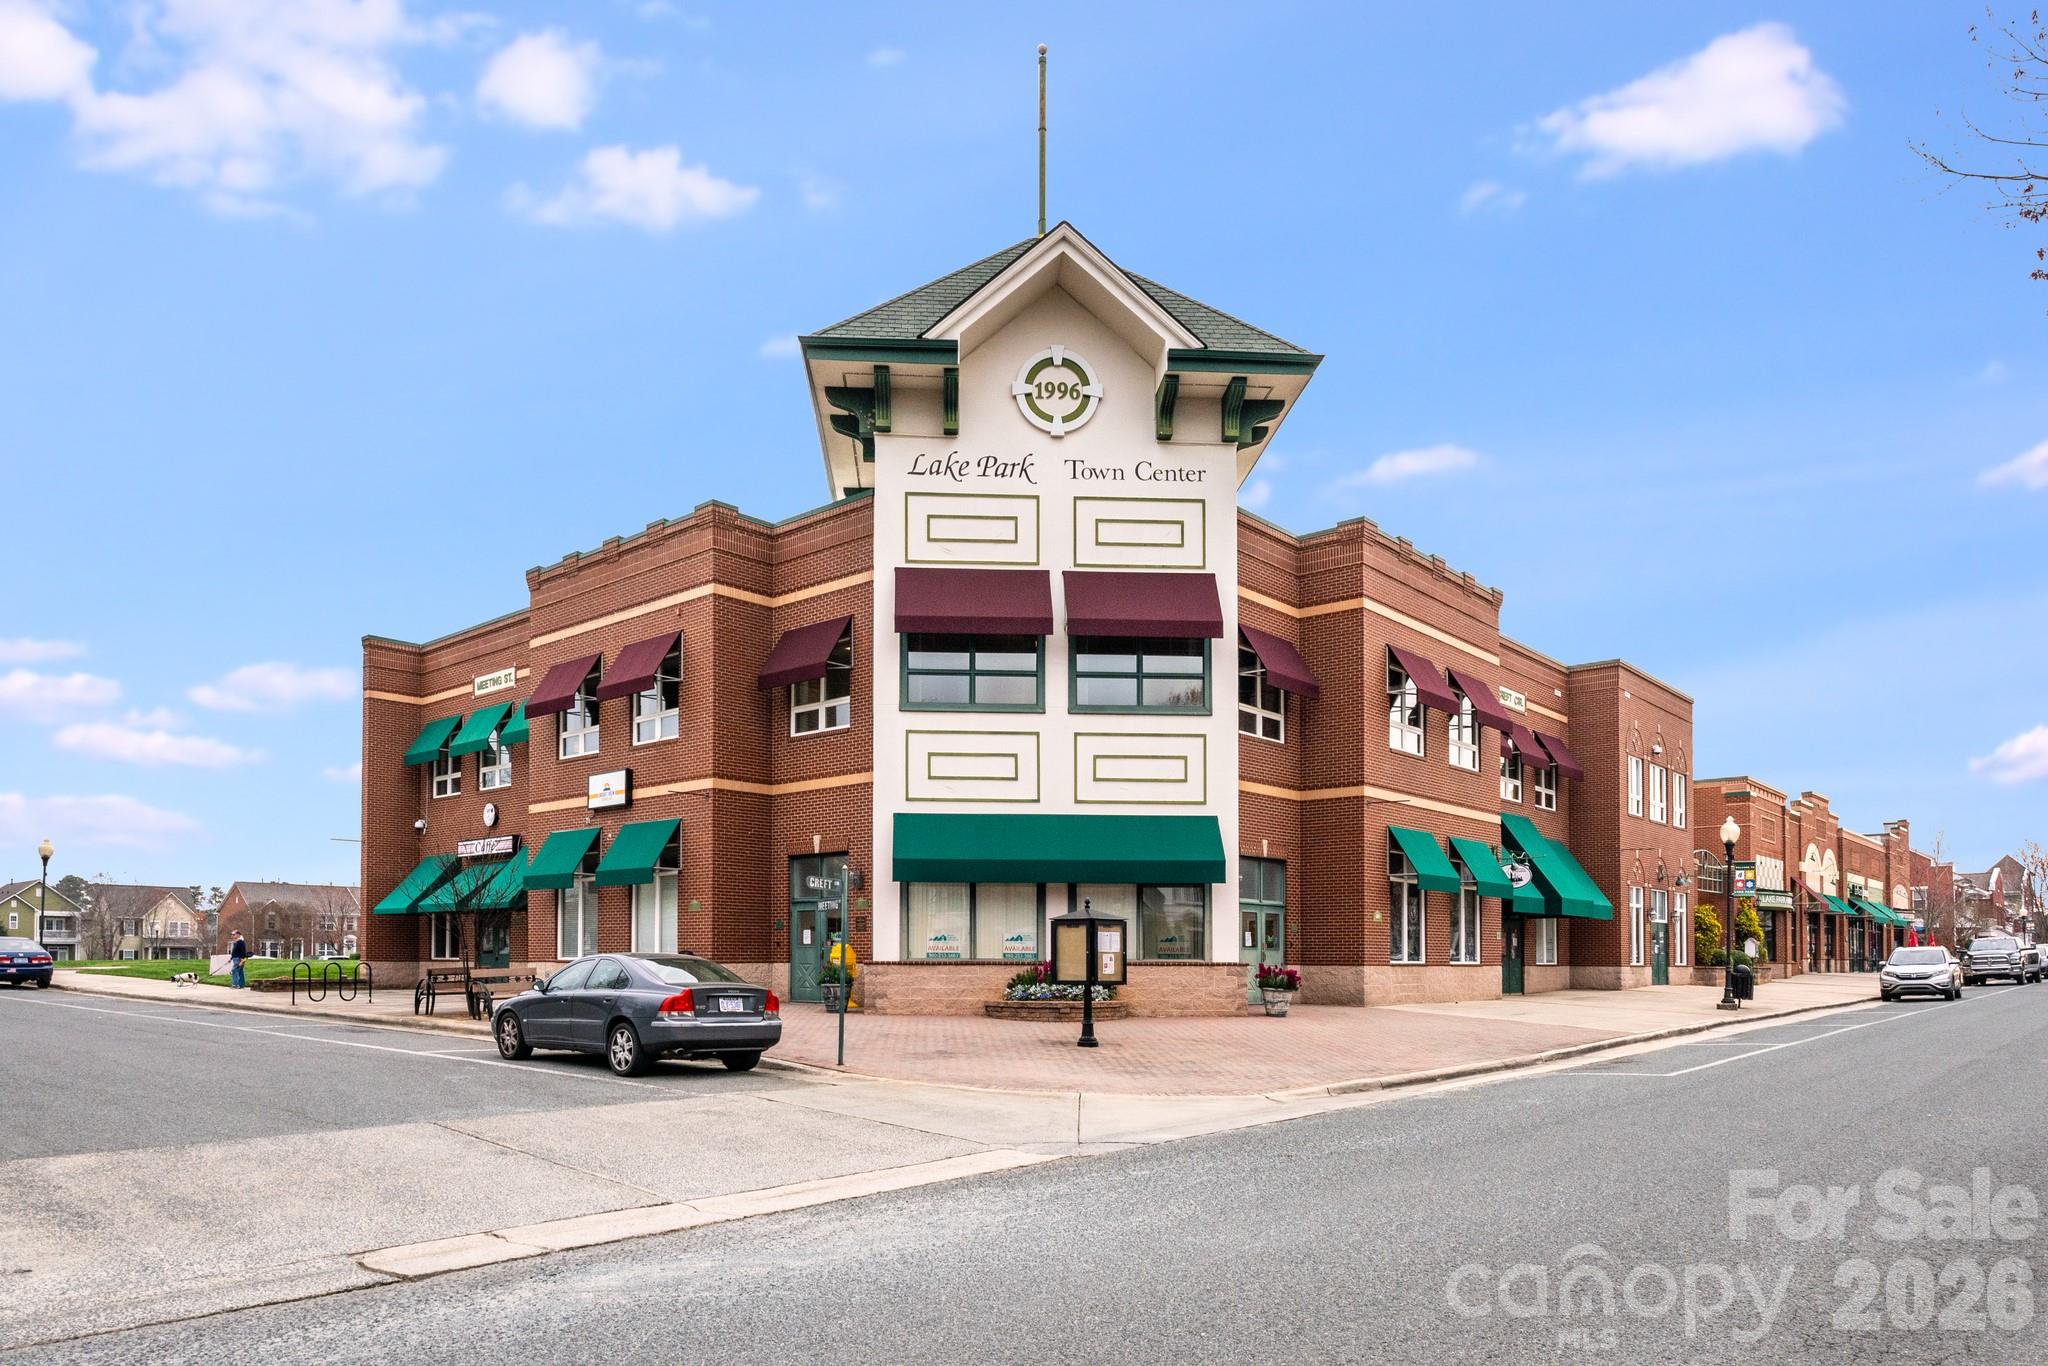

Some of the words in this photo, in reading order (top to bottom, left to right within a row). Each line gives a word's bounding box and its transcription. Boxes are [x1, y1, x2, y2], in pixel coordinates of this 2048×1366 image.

[1034, 381, 1081, 400] 1996
[907, 451, 970, 482] Lake
[976, 453, 1038, 485] Park
[1064, 459, 1126, 481] Town
[1135, 460, 1207, 483] Center
[477, 675, 502, 691] MEETING
[810, 877, 832, 889] CREFT
